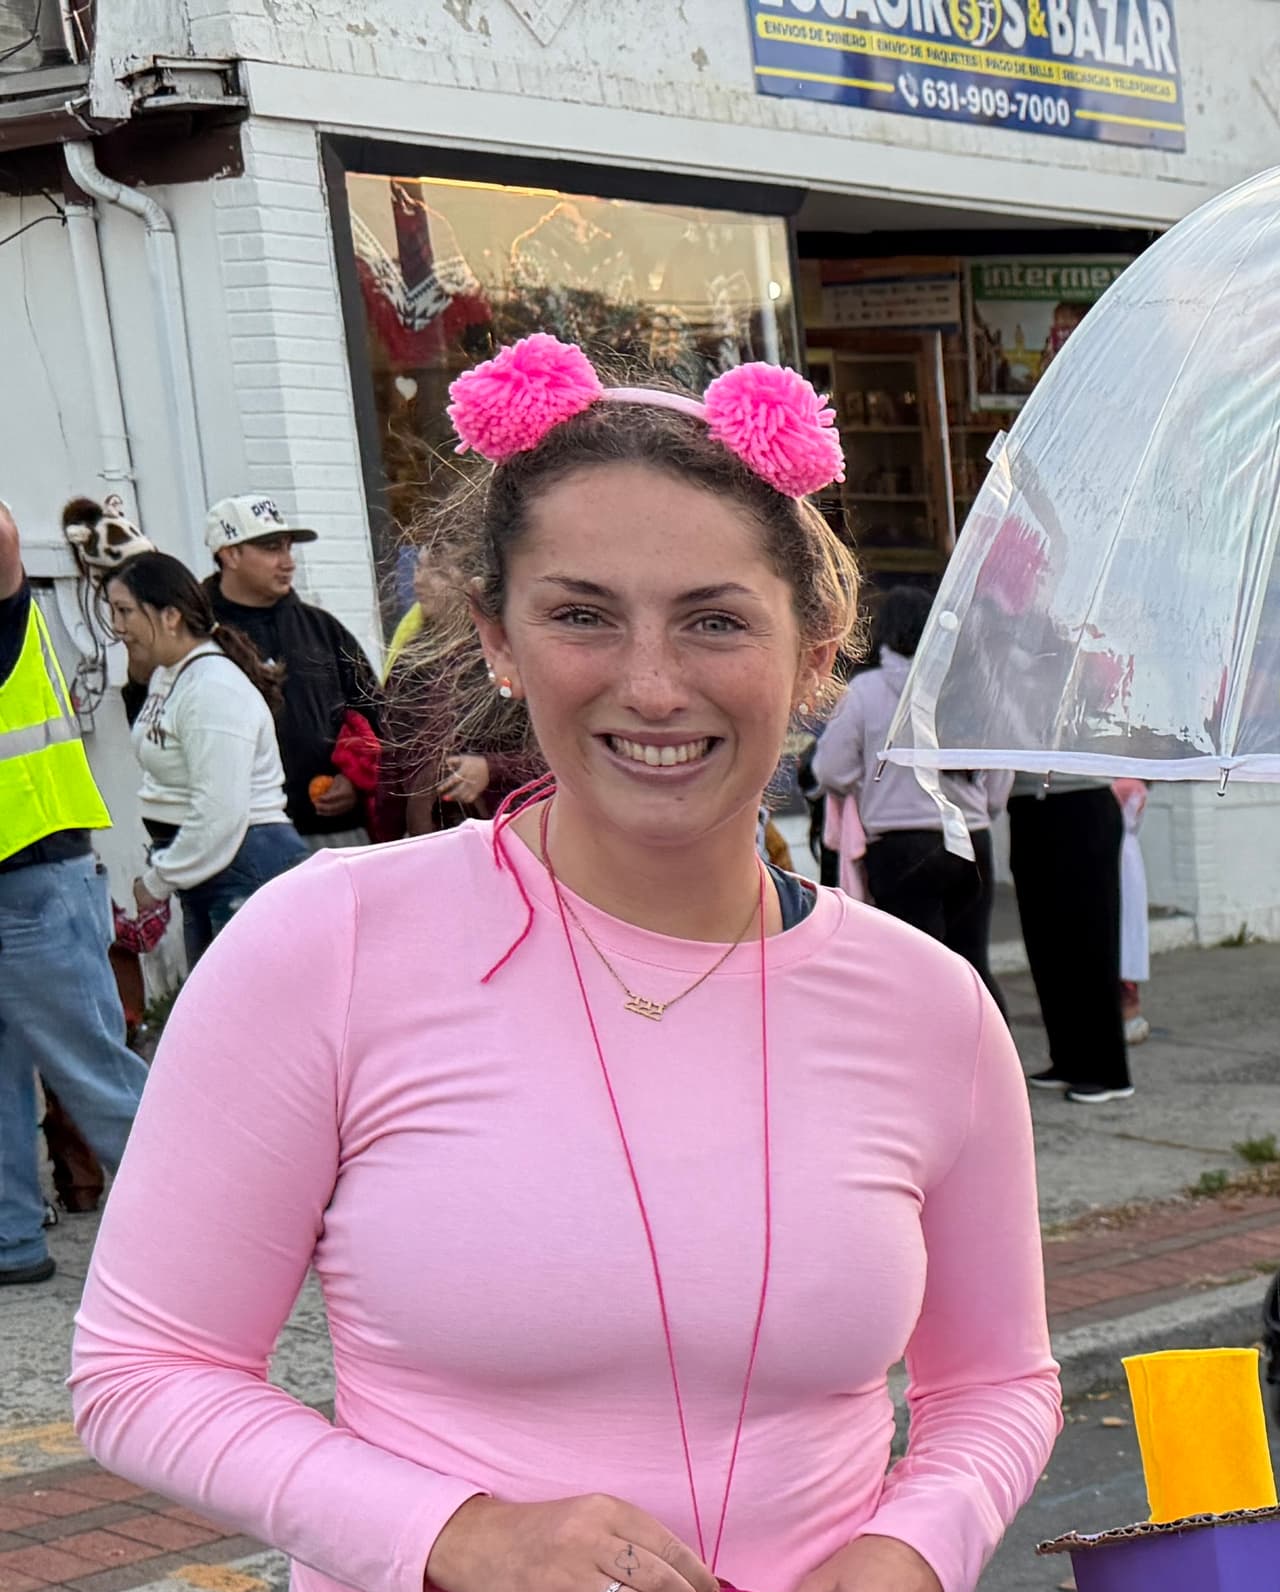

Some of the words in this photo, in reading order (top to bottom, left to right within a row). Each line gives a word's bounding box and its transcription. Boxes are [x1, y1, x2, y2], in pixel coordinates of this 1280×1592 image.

[764, 20, 807, 38] ENVIOS
[808, 28, 824, 42] DE
[826, 30, 867, 48] DINERO
[877, 37, 909, 55] ENVIO
[910, 45, 923, 58] DE
[926, 47, 978, 67] PAQUETES
[1013, 62, 1028, 75] DE
[1049, 0, 1177, 74] BAZAR
[922, 77, 1071, 127] 631-909-7000
